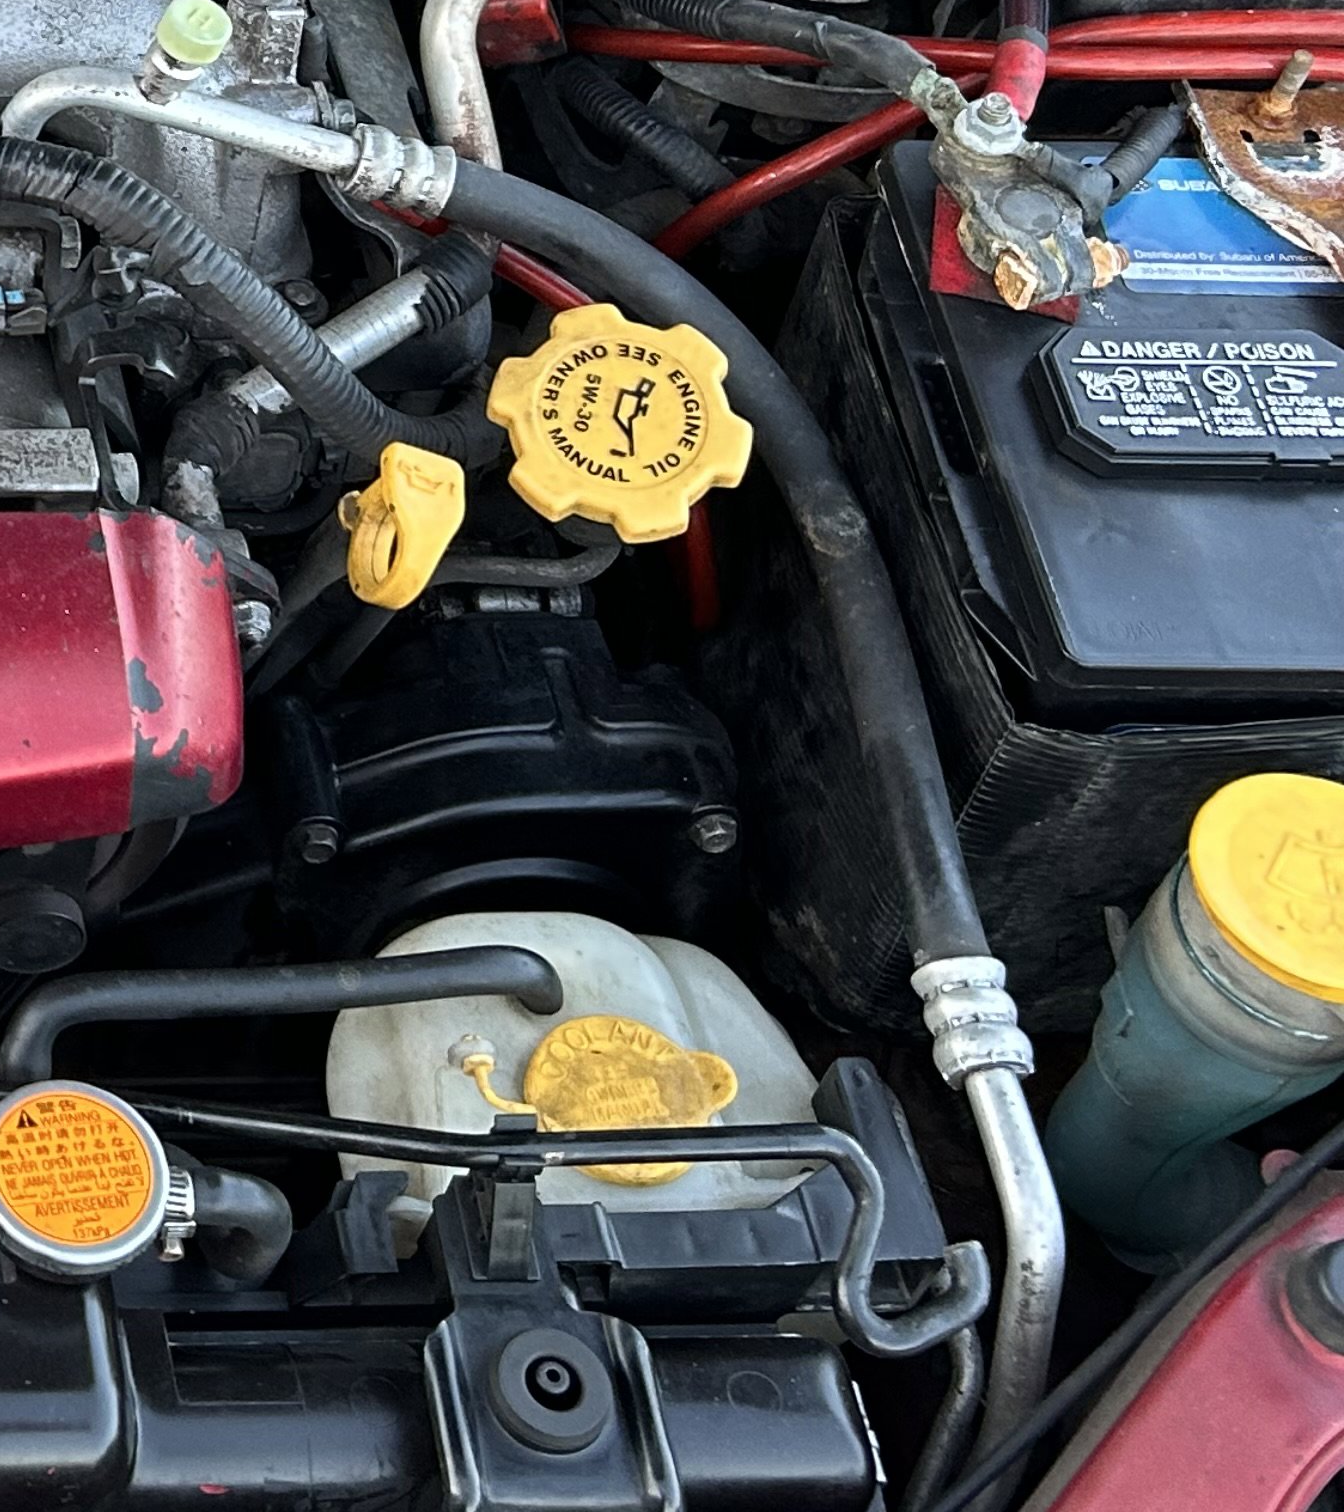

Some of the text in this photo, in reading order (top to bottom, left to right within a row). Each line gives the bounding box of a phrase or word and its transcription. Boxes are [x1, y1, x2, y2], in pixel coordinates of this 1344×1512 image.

[1133, 249, 1196, 261] Distributed
[1199, 251, 1215, 263] by
[1219, 251, 1261, 263] Subaru
[616, 343, 662, 368] SEE
[1101, 341, 1202, 359] DANGER
[1223, 343, 1316, 360] POISON
[643, 369, 702, 479] ENGINE OIL
[547, 427, 631, 484] MANUAL
[541, 1020, 679, 1081] COOLANT
[40, 1111, 100, 1127] WARNING
[1, 1160, 38, 1176] NEVER
[42, 1156, 73, 1171] OPEN
[76, 1151, 112, 1167] WHEN
[35, 1193, 130, 1217] AVERTISSEMENT
